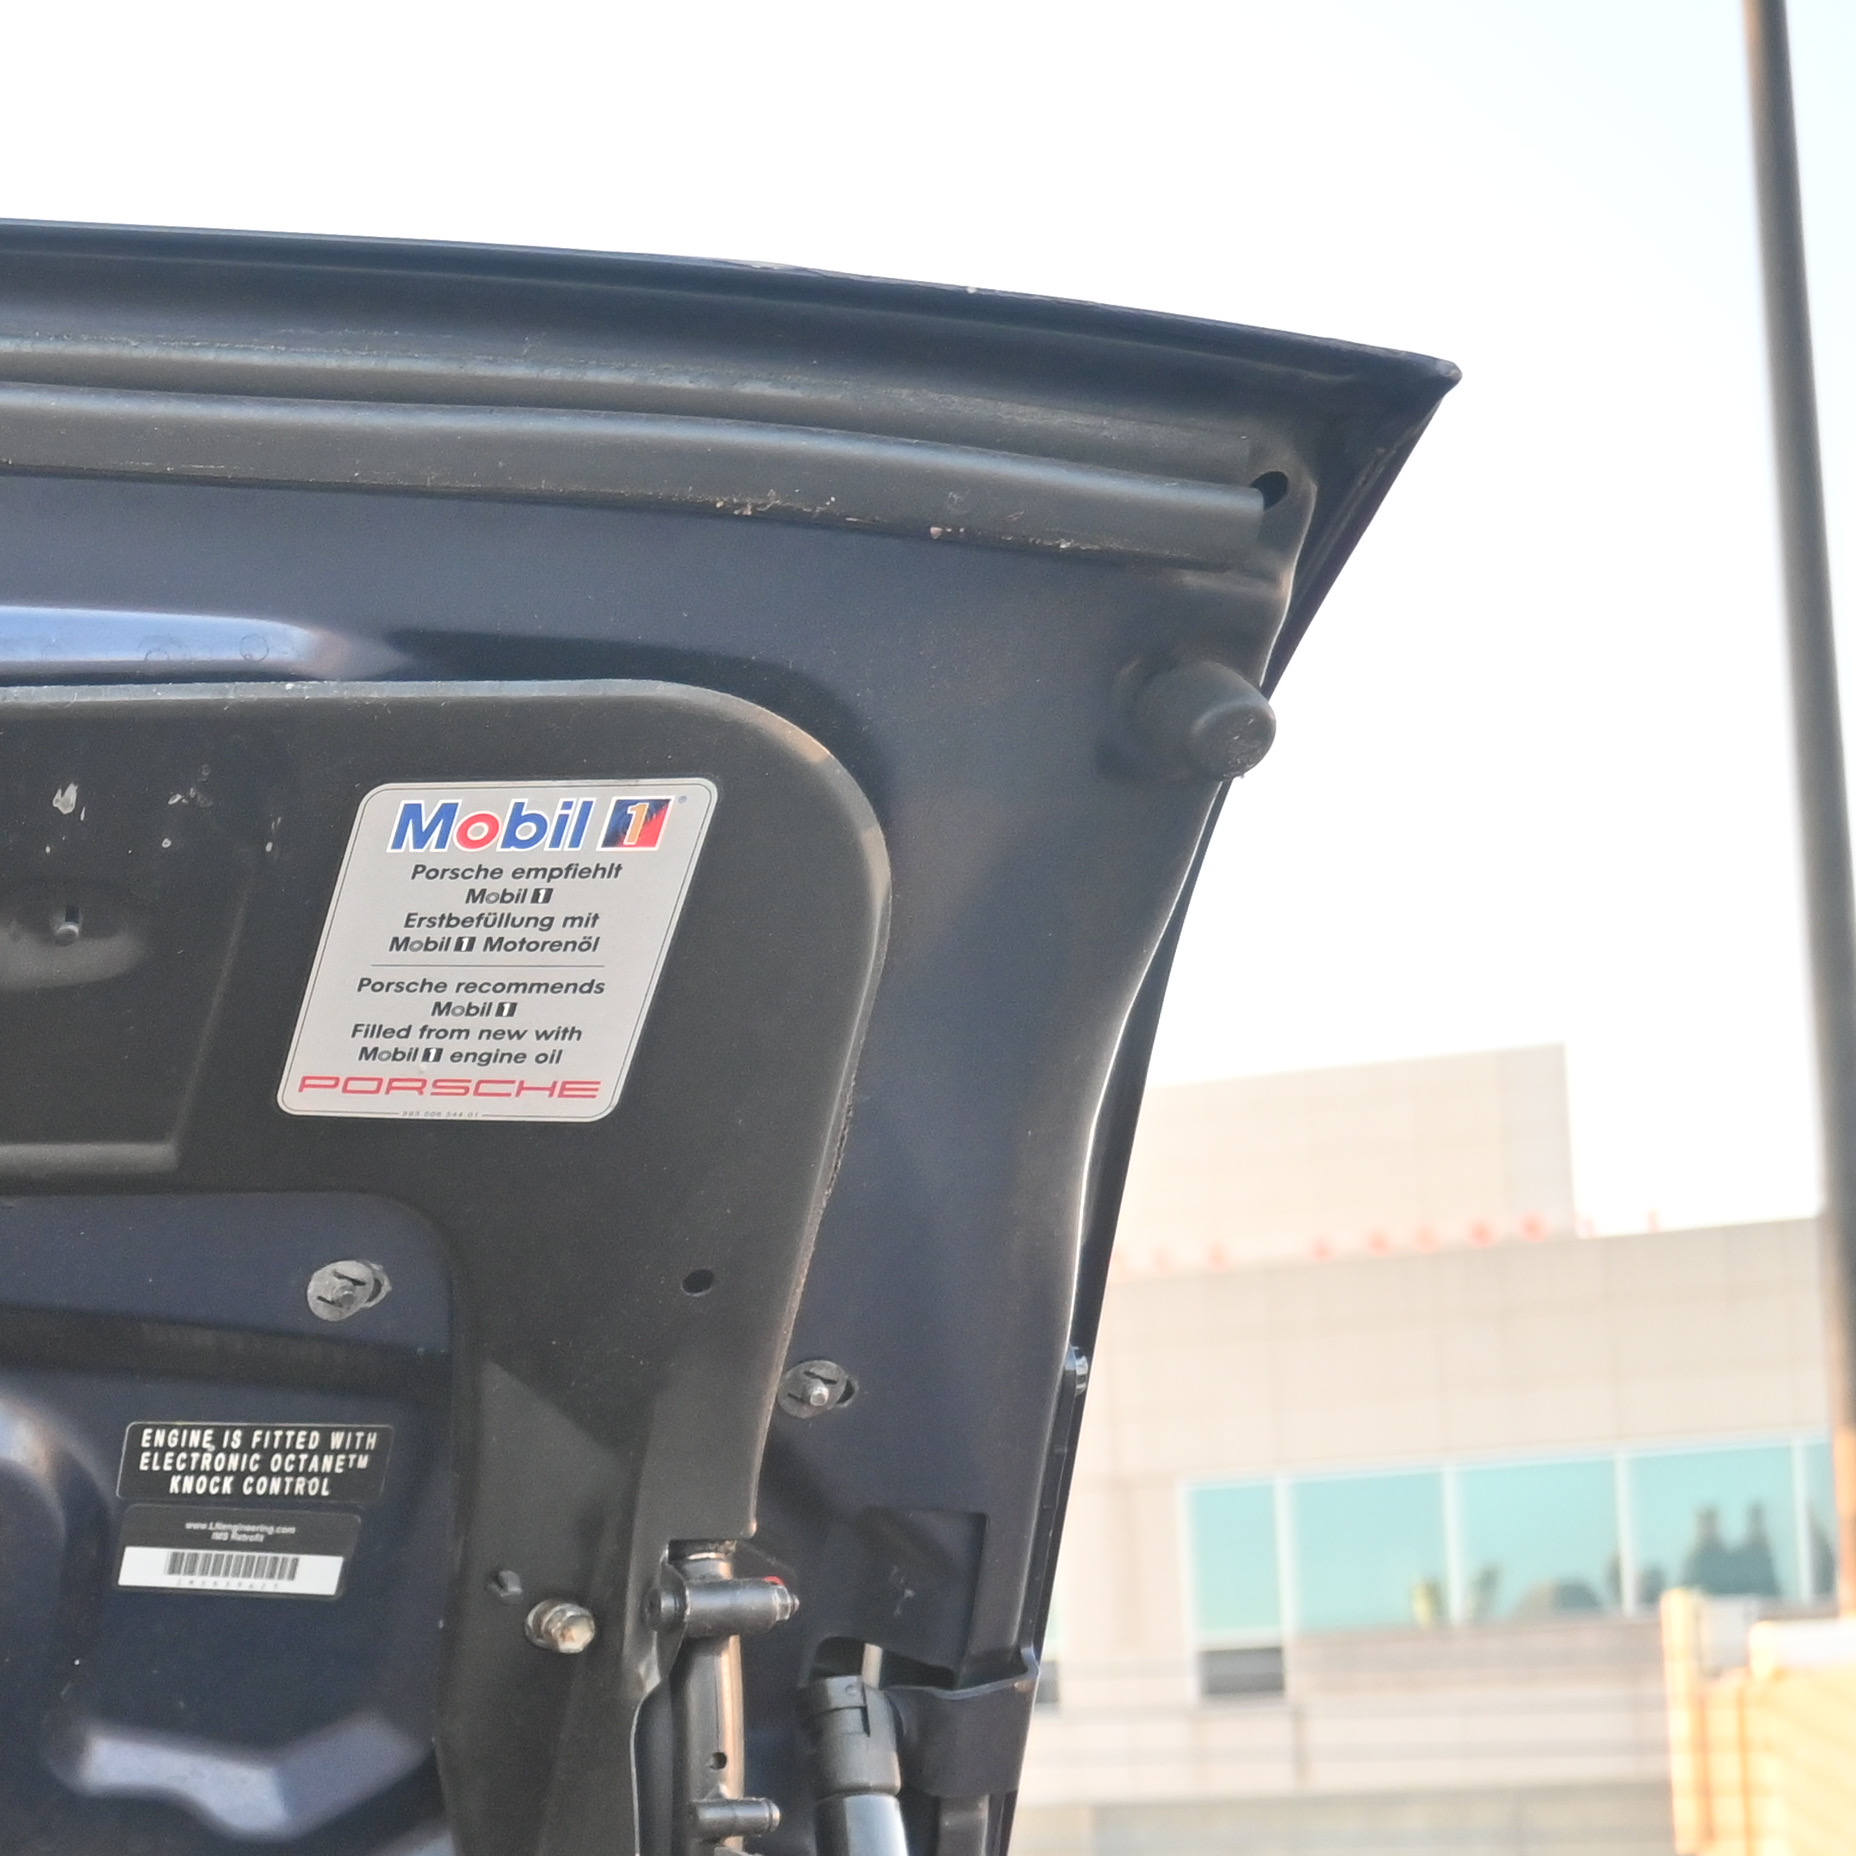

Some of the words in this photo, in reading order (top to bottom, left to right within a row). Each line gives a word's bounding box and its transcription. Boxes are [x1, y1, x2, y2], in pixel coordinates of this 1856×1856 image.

[387, 797, 597, 853] Mobil
[411, 864, 503, 880] Porsche
[511, 862, 623, 883] empfiehlt
[465, 888, 528, 905] Mobil
[403, 912, 555, 932] Erstbefüllung
[562, 913, 600, 928] mit
[388, 936, 452, 953] Mobil
[482, 936, 600, 953] Motorenöl
[357, 978, 448, 995] Porsche
[455, 979, 605, 996] recommends
[430, 1001, 493, 1018] Mobil
[350, 1023, 413, 1041] Filled
[418, 1024, 471, 1042] from
[477, 1028, 527, 1042] new
[534, 1026, 583, 1042] with
[358, 1047, 419, 1063] Mobil
[449, 1051, 527, 1067] engine
[535, 1048, 563, 1065] oil
[298, 1075, 601, 1099] PORSCHE
[140, 1428, 213, 1449] ENGINE
[222, 1430, 241, 1449] IS
[251, 1430, 319, 1450] FITTED
[330, 1431, 378, 1451] WITH
[139, 1451, 261, 1472] ELECTRONIC
[168, 1475, 234, 1495] KNOCK
[242, 1476, 331, 1497] CONTROL
